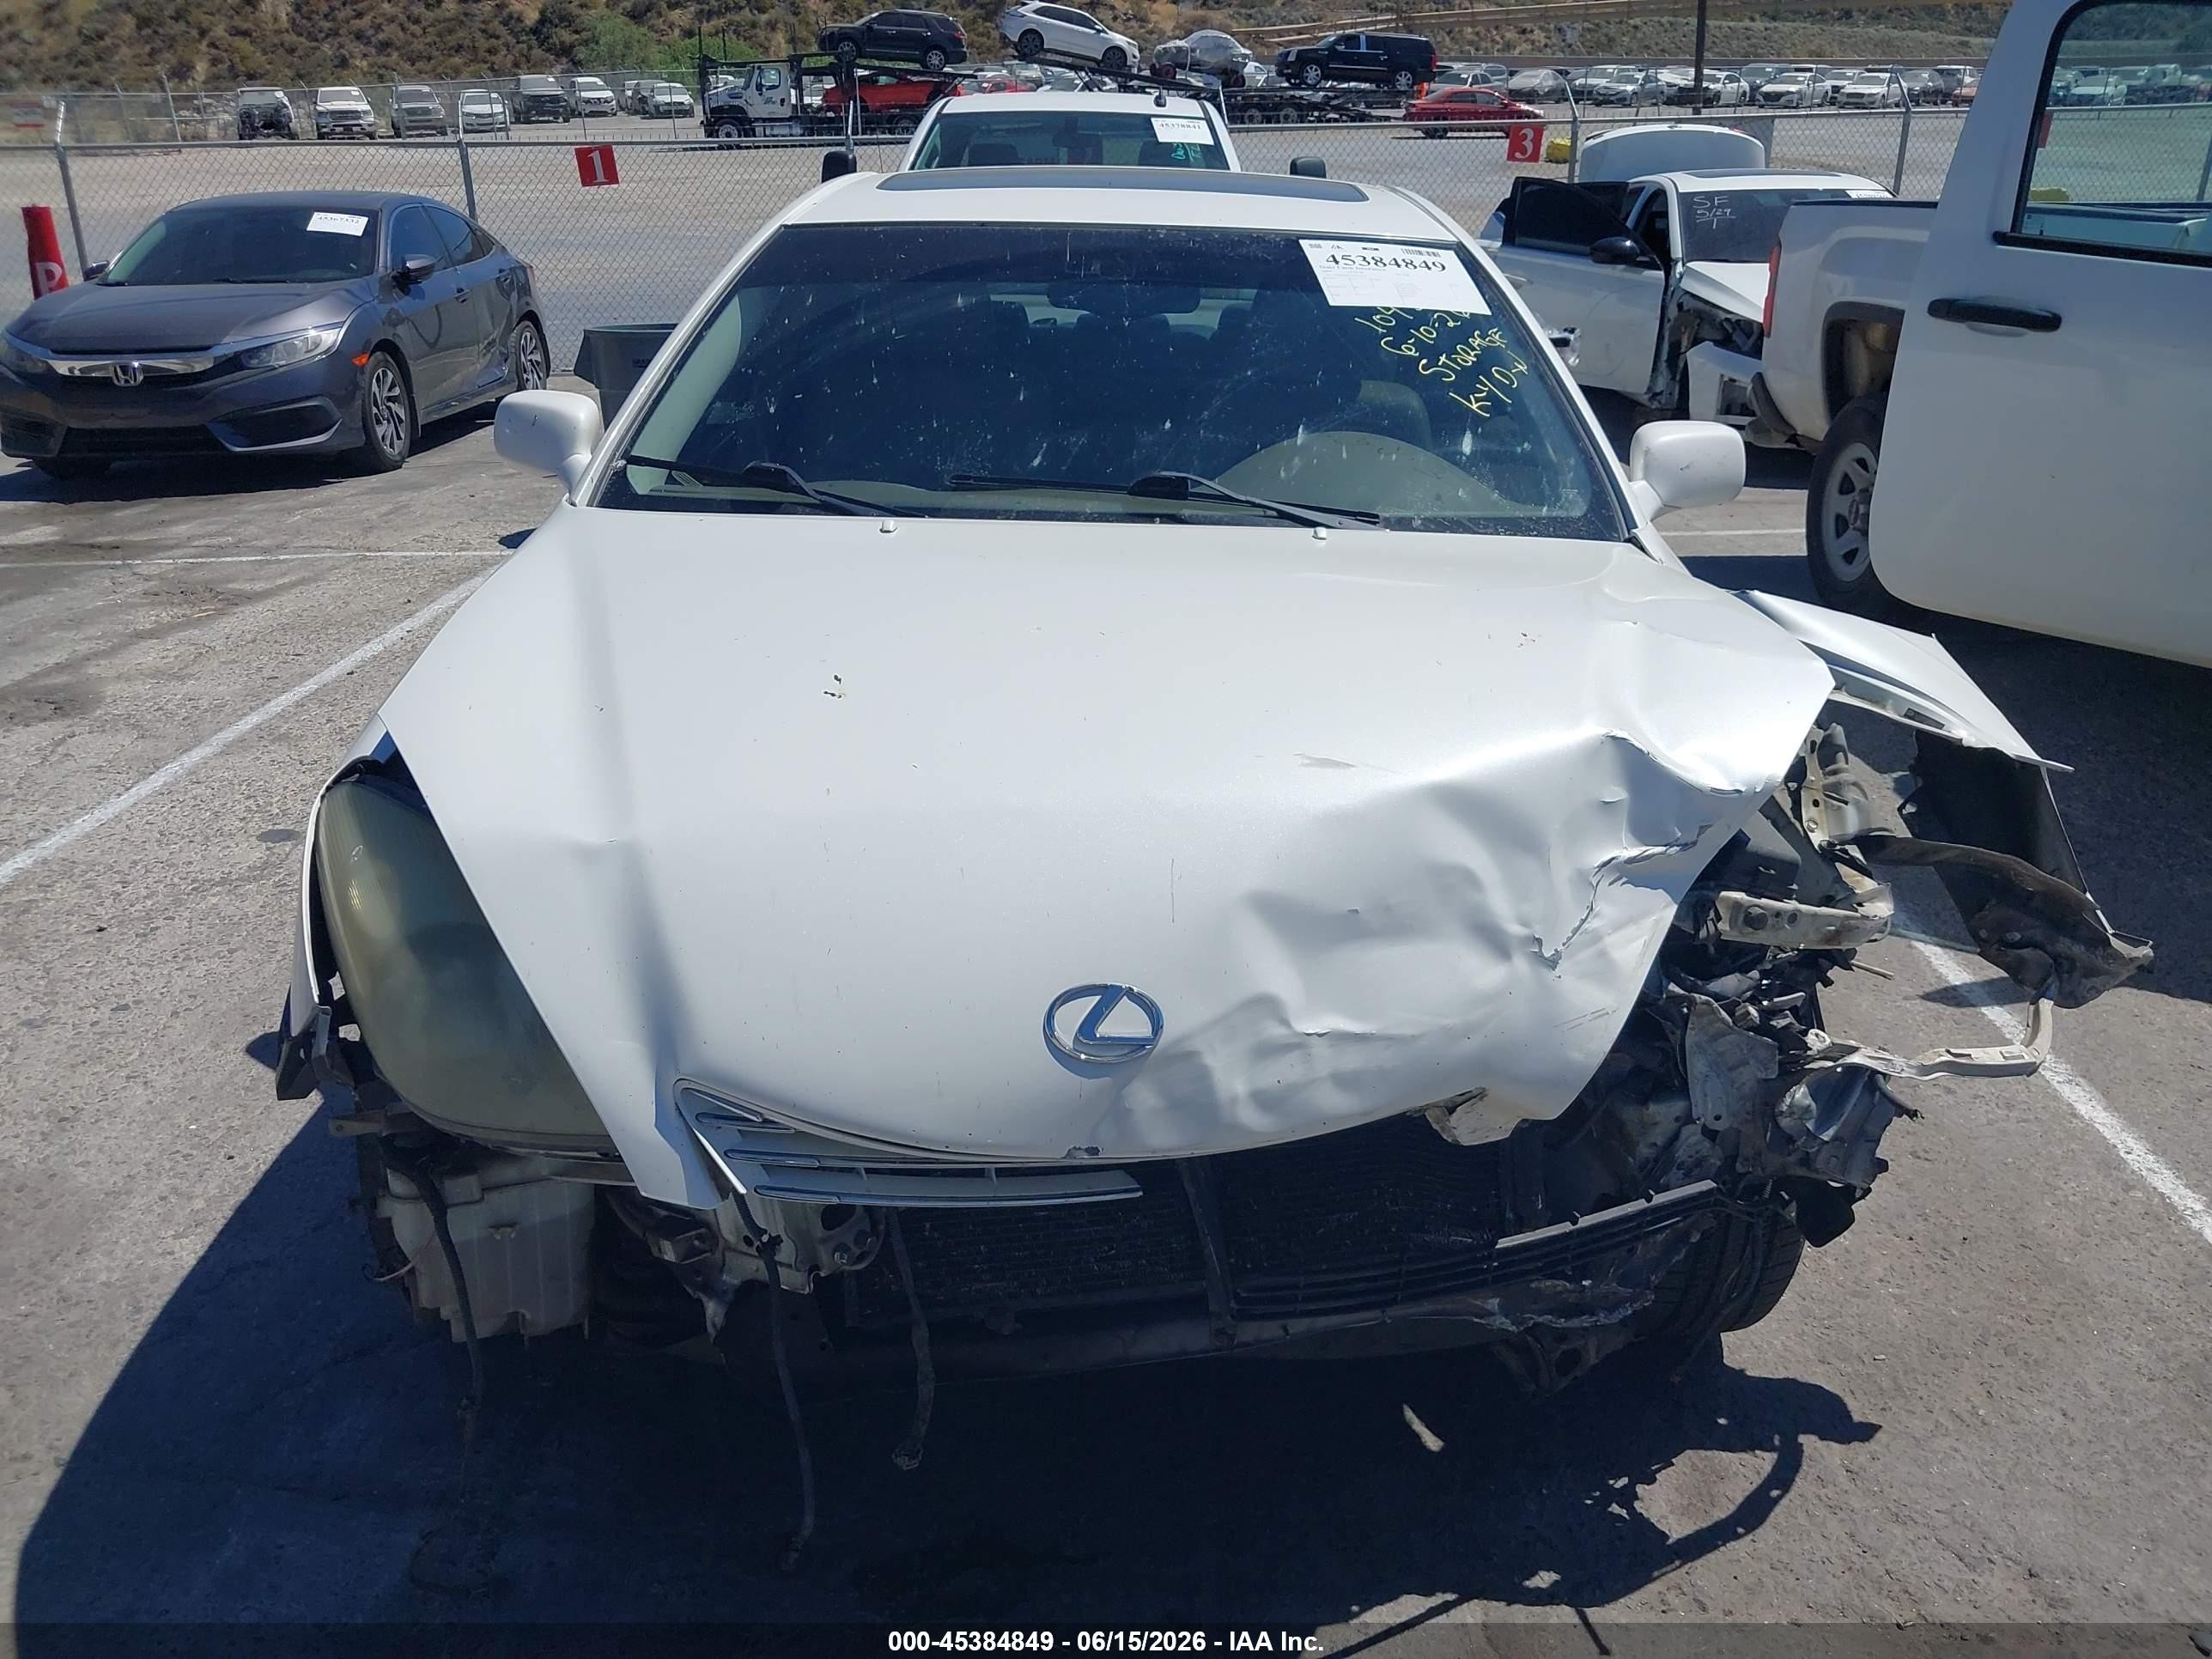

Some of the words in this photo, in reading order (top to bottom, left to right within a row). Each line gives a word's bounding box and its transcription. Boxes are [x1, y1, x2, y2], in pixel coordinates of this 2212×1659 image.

[1514, 128, 1534, 160] 3
[587, 150, 611, 184] 1
[35, 261, 63, 295] P
[1326, 253, 1447, 272] 45384849
